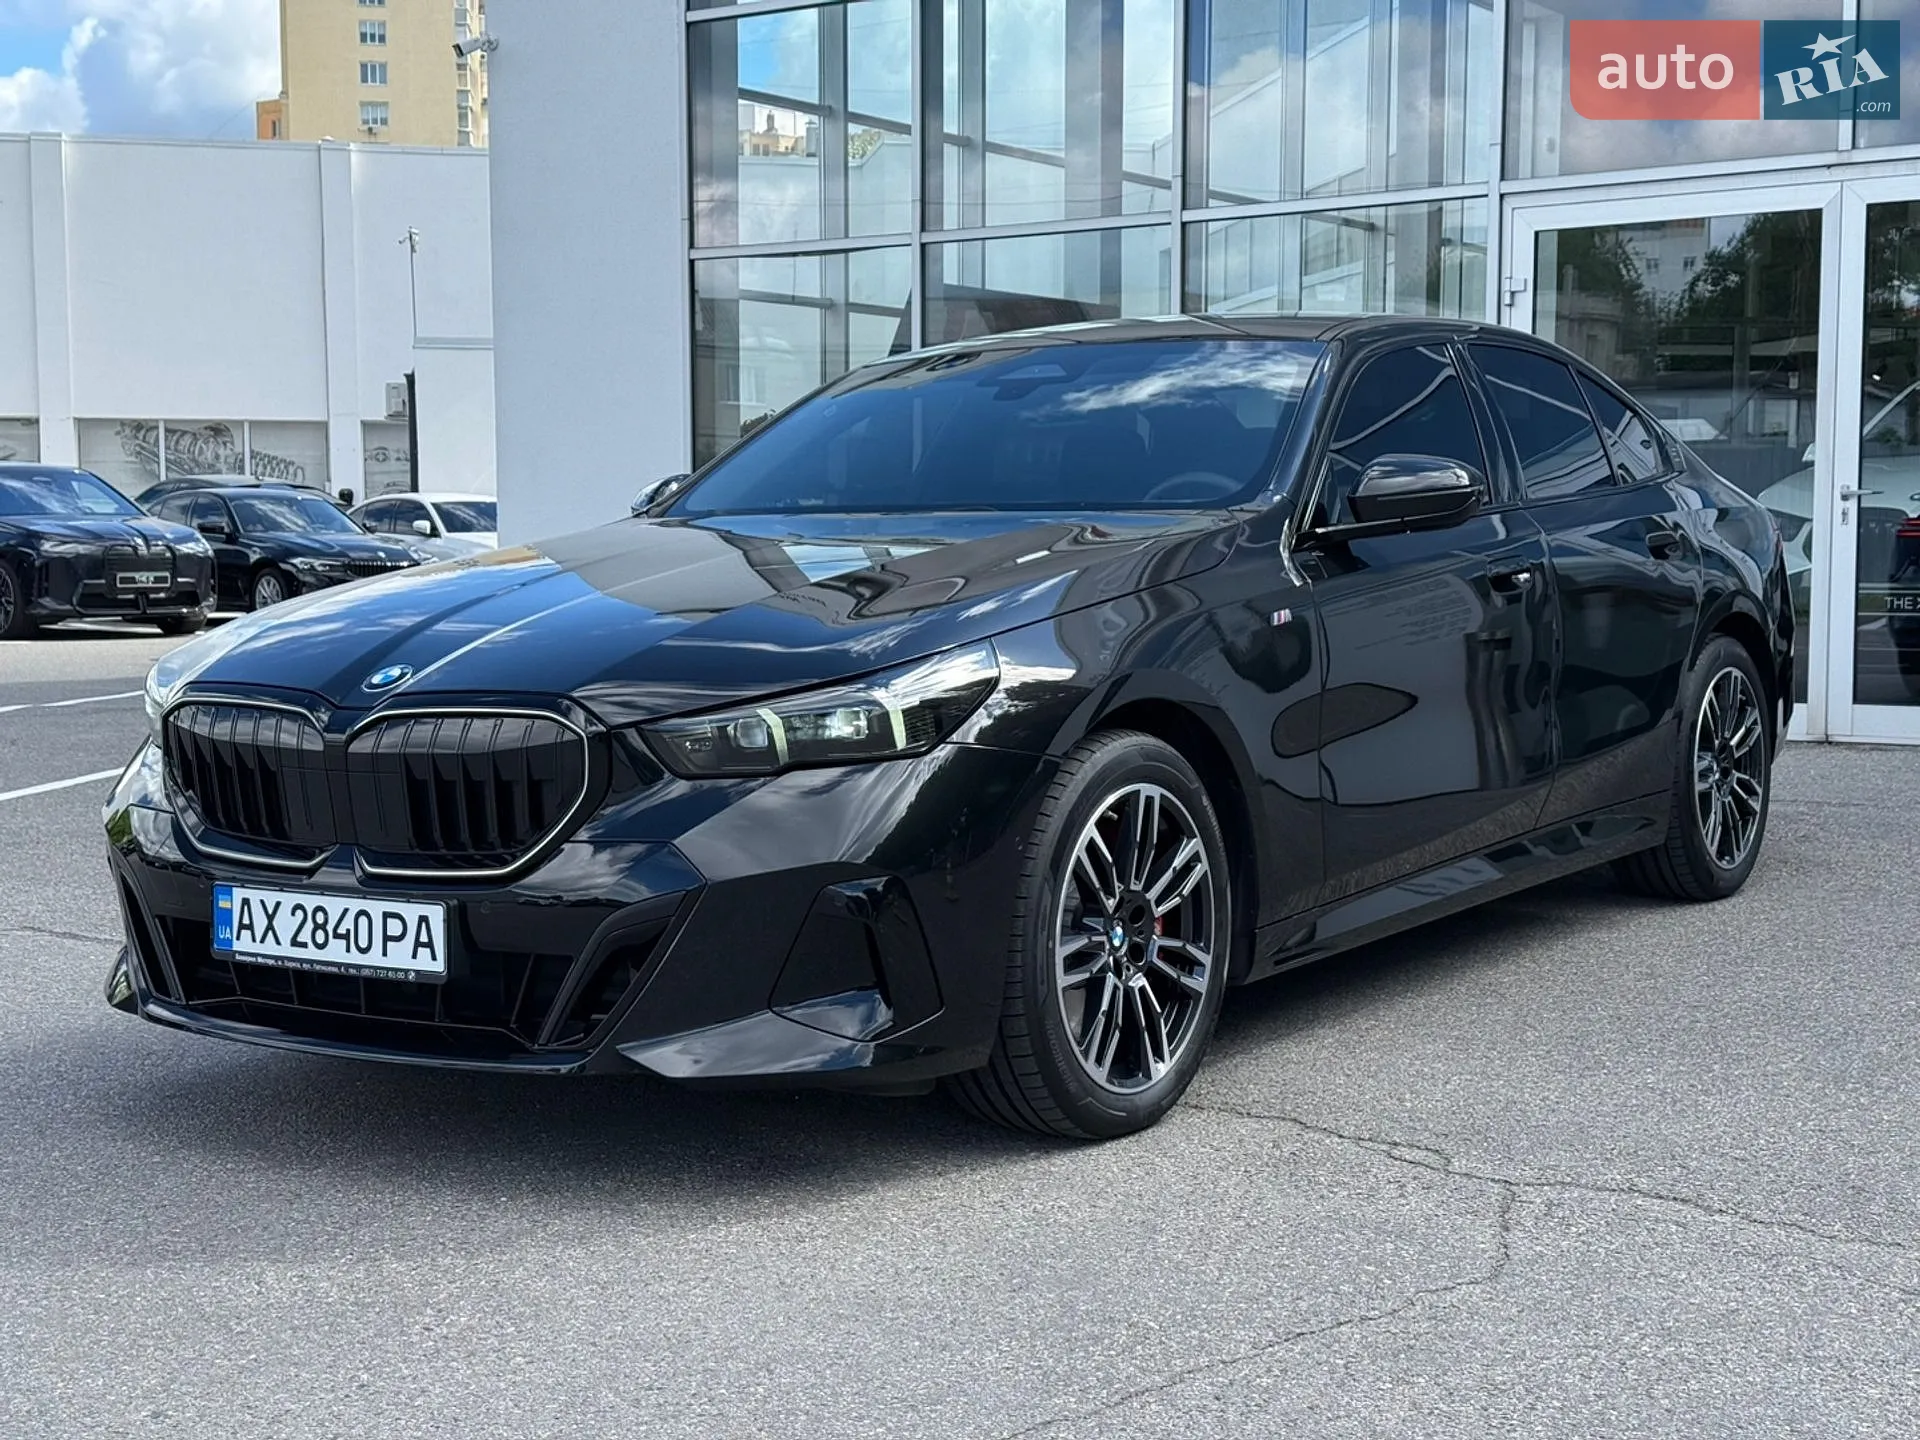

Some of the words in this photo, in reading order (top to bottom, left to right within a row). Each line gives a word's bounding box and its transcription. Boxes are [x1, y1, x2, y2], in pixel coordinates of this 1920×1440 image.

[1884, 596, 1913, 609] THE
[218, 925, 232, 940] UA
[236, 897, 282, 946] AX
[290, 902, 373, 955] 2840
[382, 910, 437, 962] PA
